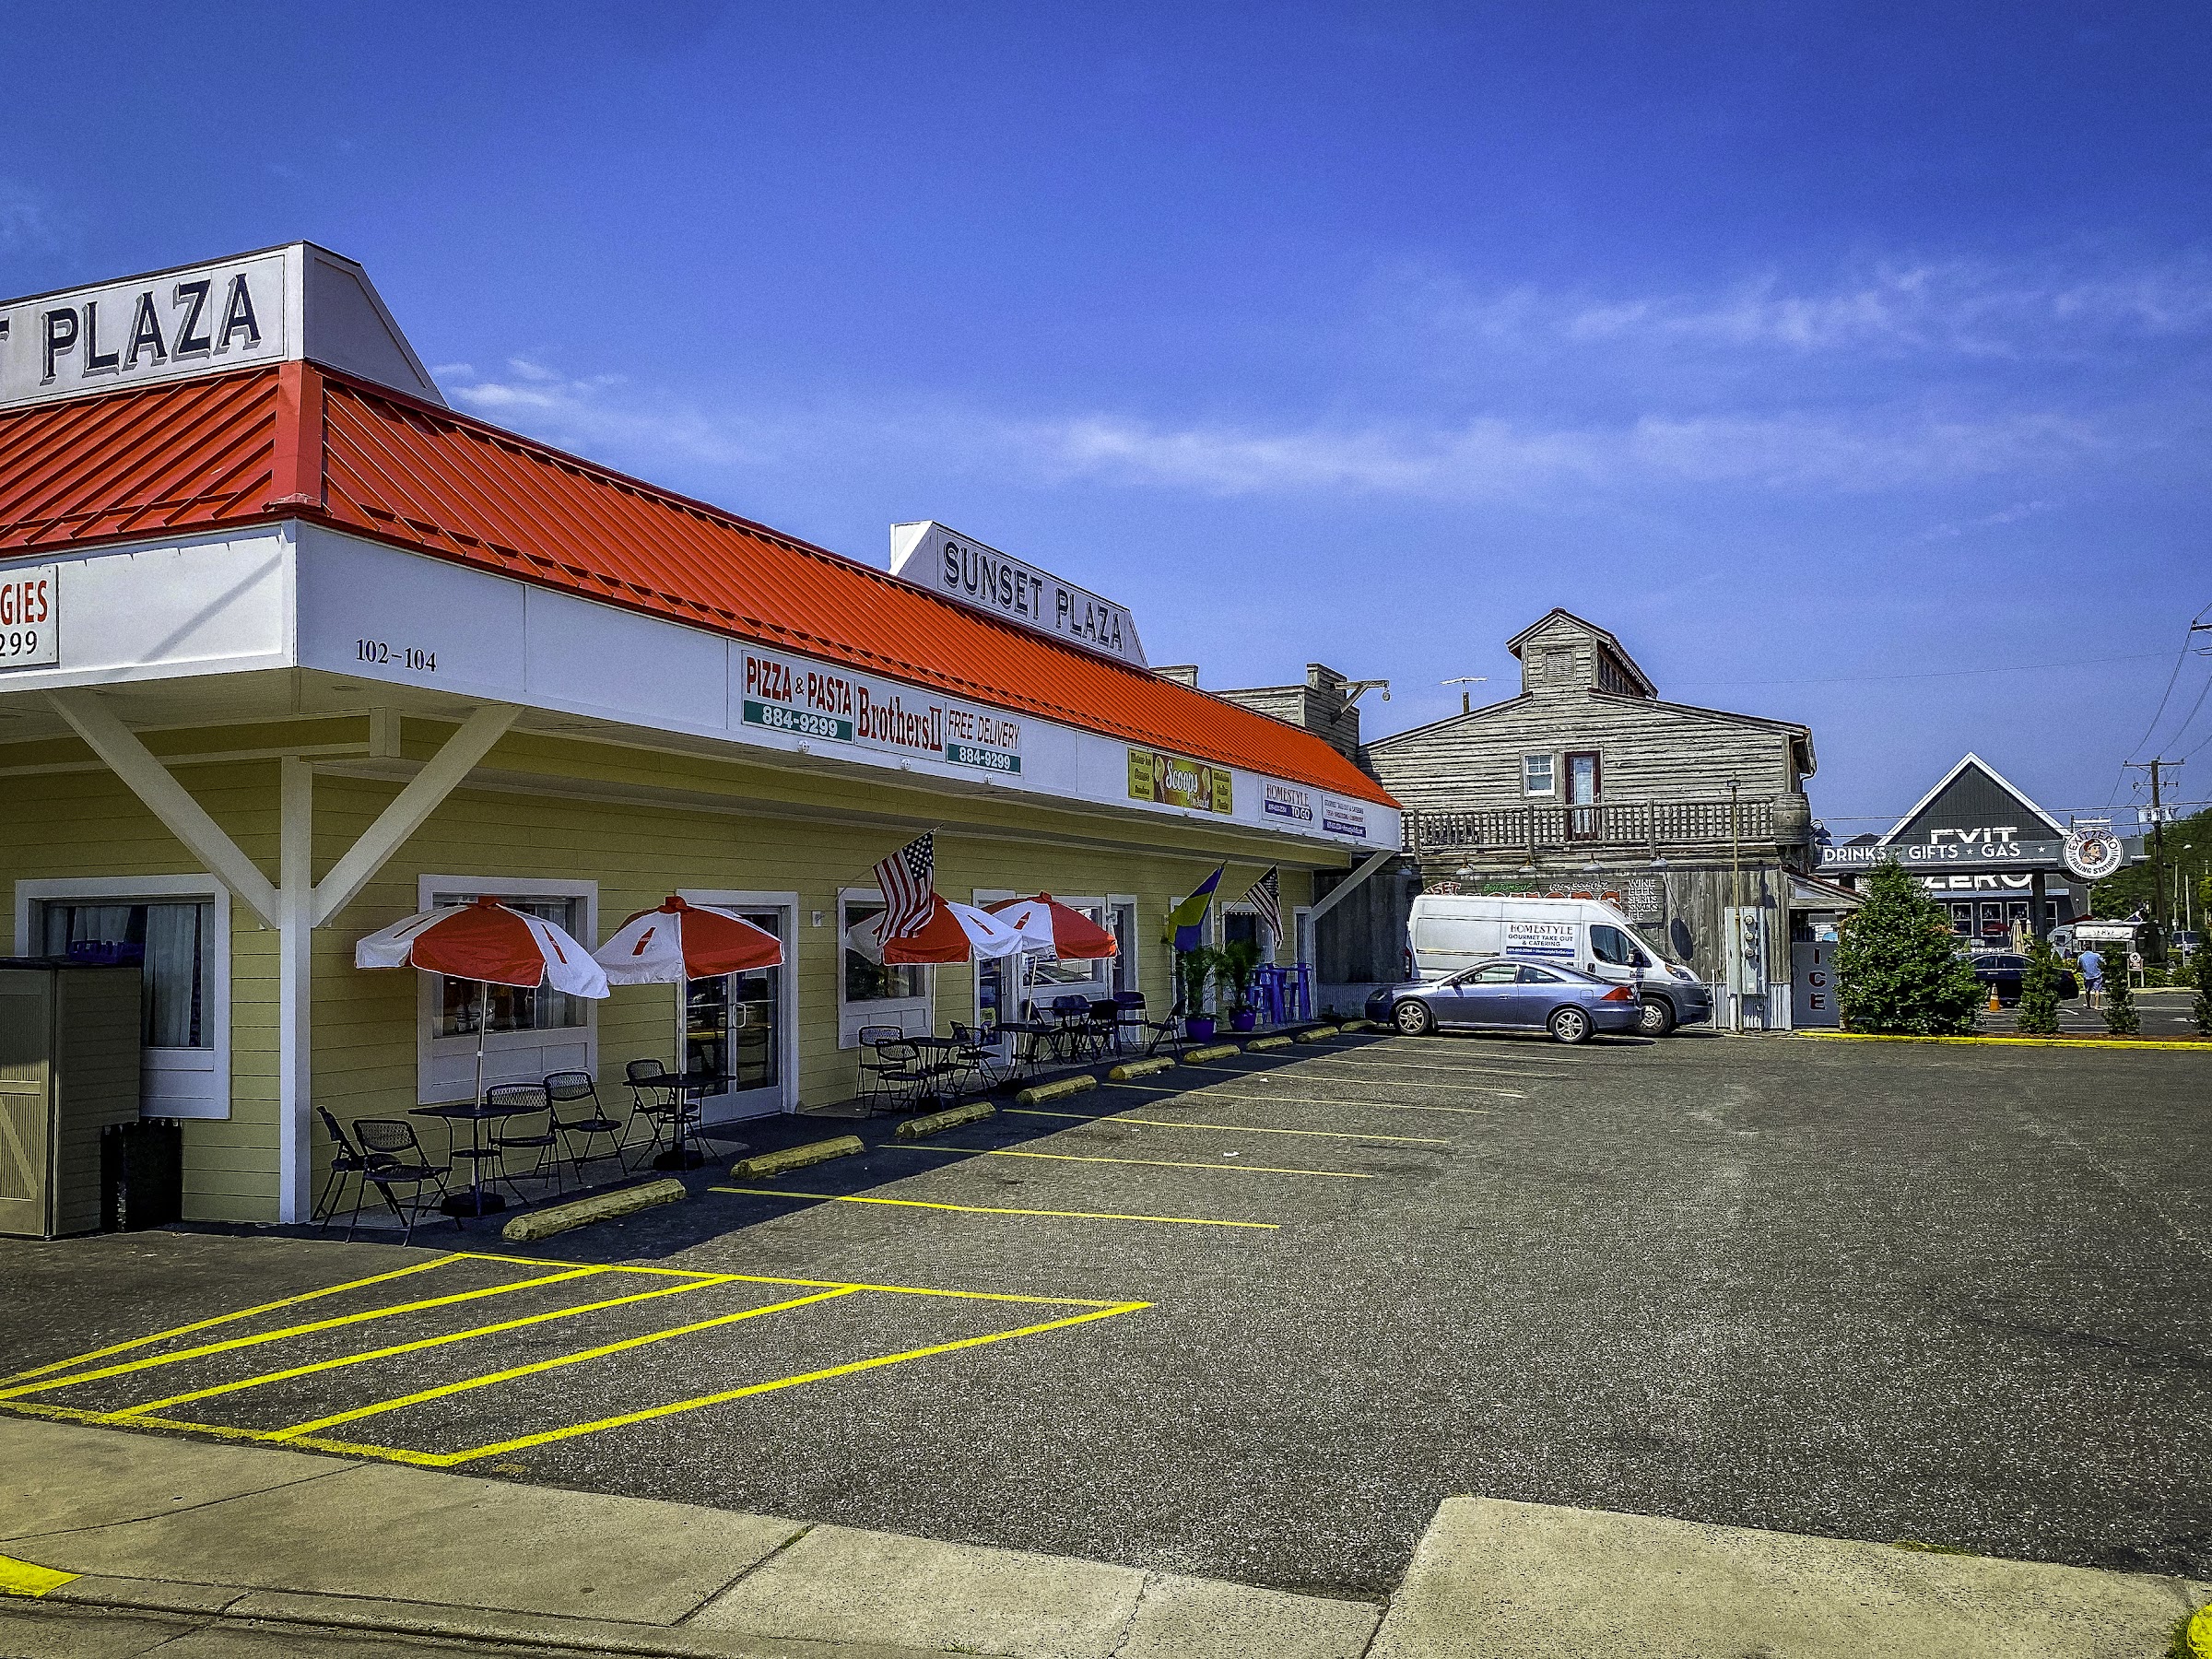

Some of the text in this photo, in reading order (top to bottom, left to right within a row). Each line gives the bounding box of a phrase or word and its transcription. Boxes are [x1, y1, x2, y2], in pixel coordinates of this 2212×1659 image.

[40, 273, 261, 386] PLAZA
[944, 540, 1123, 652] SUNSET PLAZA
[356, 639, 437, 672] 102-104
[747, 656, 853, 716] PIZZA & PASTA
[762, 705, 838, 736] 884-9299
[949, 710, 1020, 750] FREE DELIVERY
[959, 746, 1011, 770] 884-9299
[1166, 759, 1198, 800] Scoops
[1266, 783, 1309, 806] HOMESTYLE
[1291, 806, 1300, 818] TO
[1300, 809, 1311, 820] GO
[1824, 842, 2020, 862] DRINKS GIFTS GAS
[2069, 830, 2118, 851] EXIT ZERO
[2070, 857, 2117, 874] FILLING STATION
[1629, 879, 1655, 888] WINE
[1629, 888, 1655, 896] BEER
[1511, 924, 1573, 935] HOMESTYLE
[1808, 947, 1827, 1011] ICE
